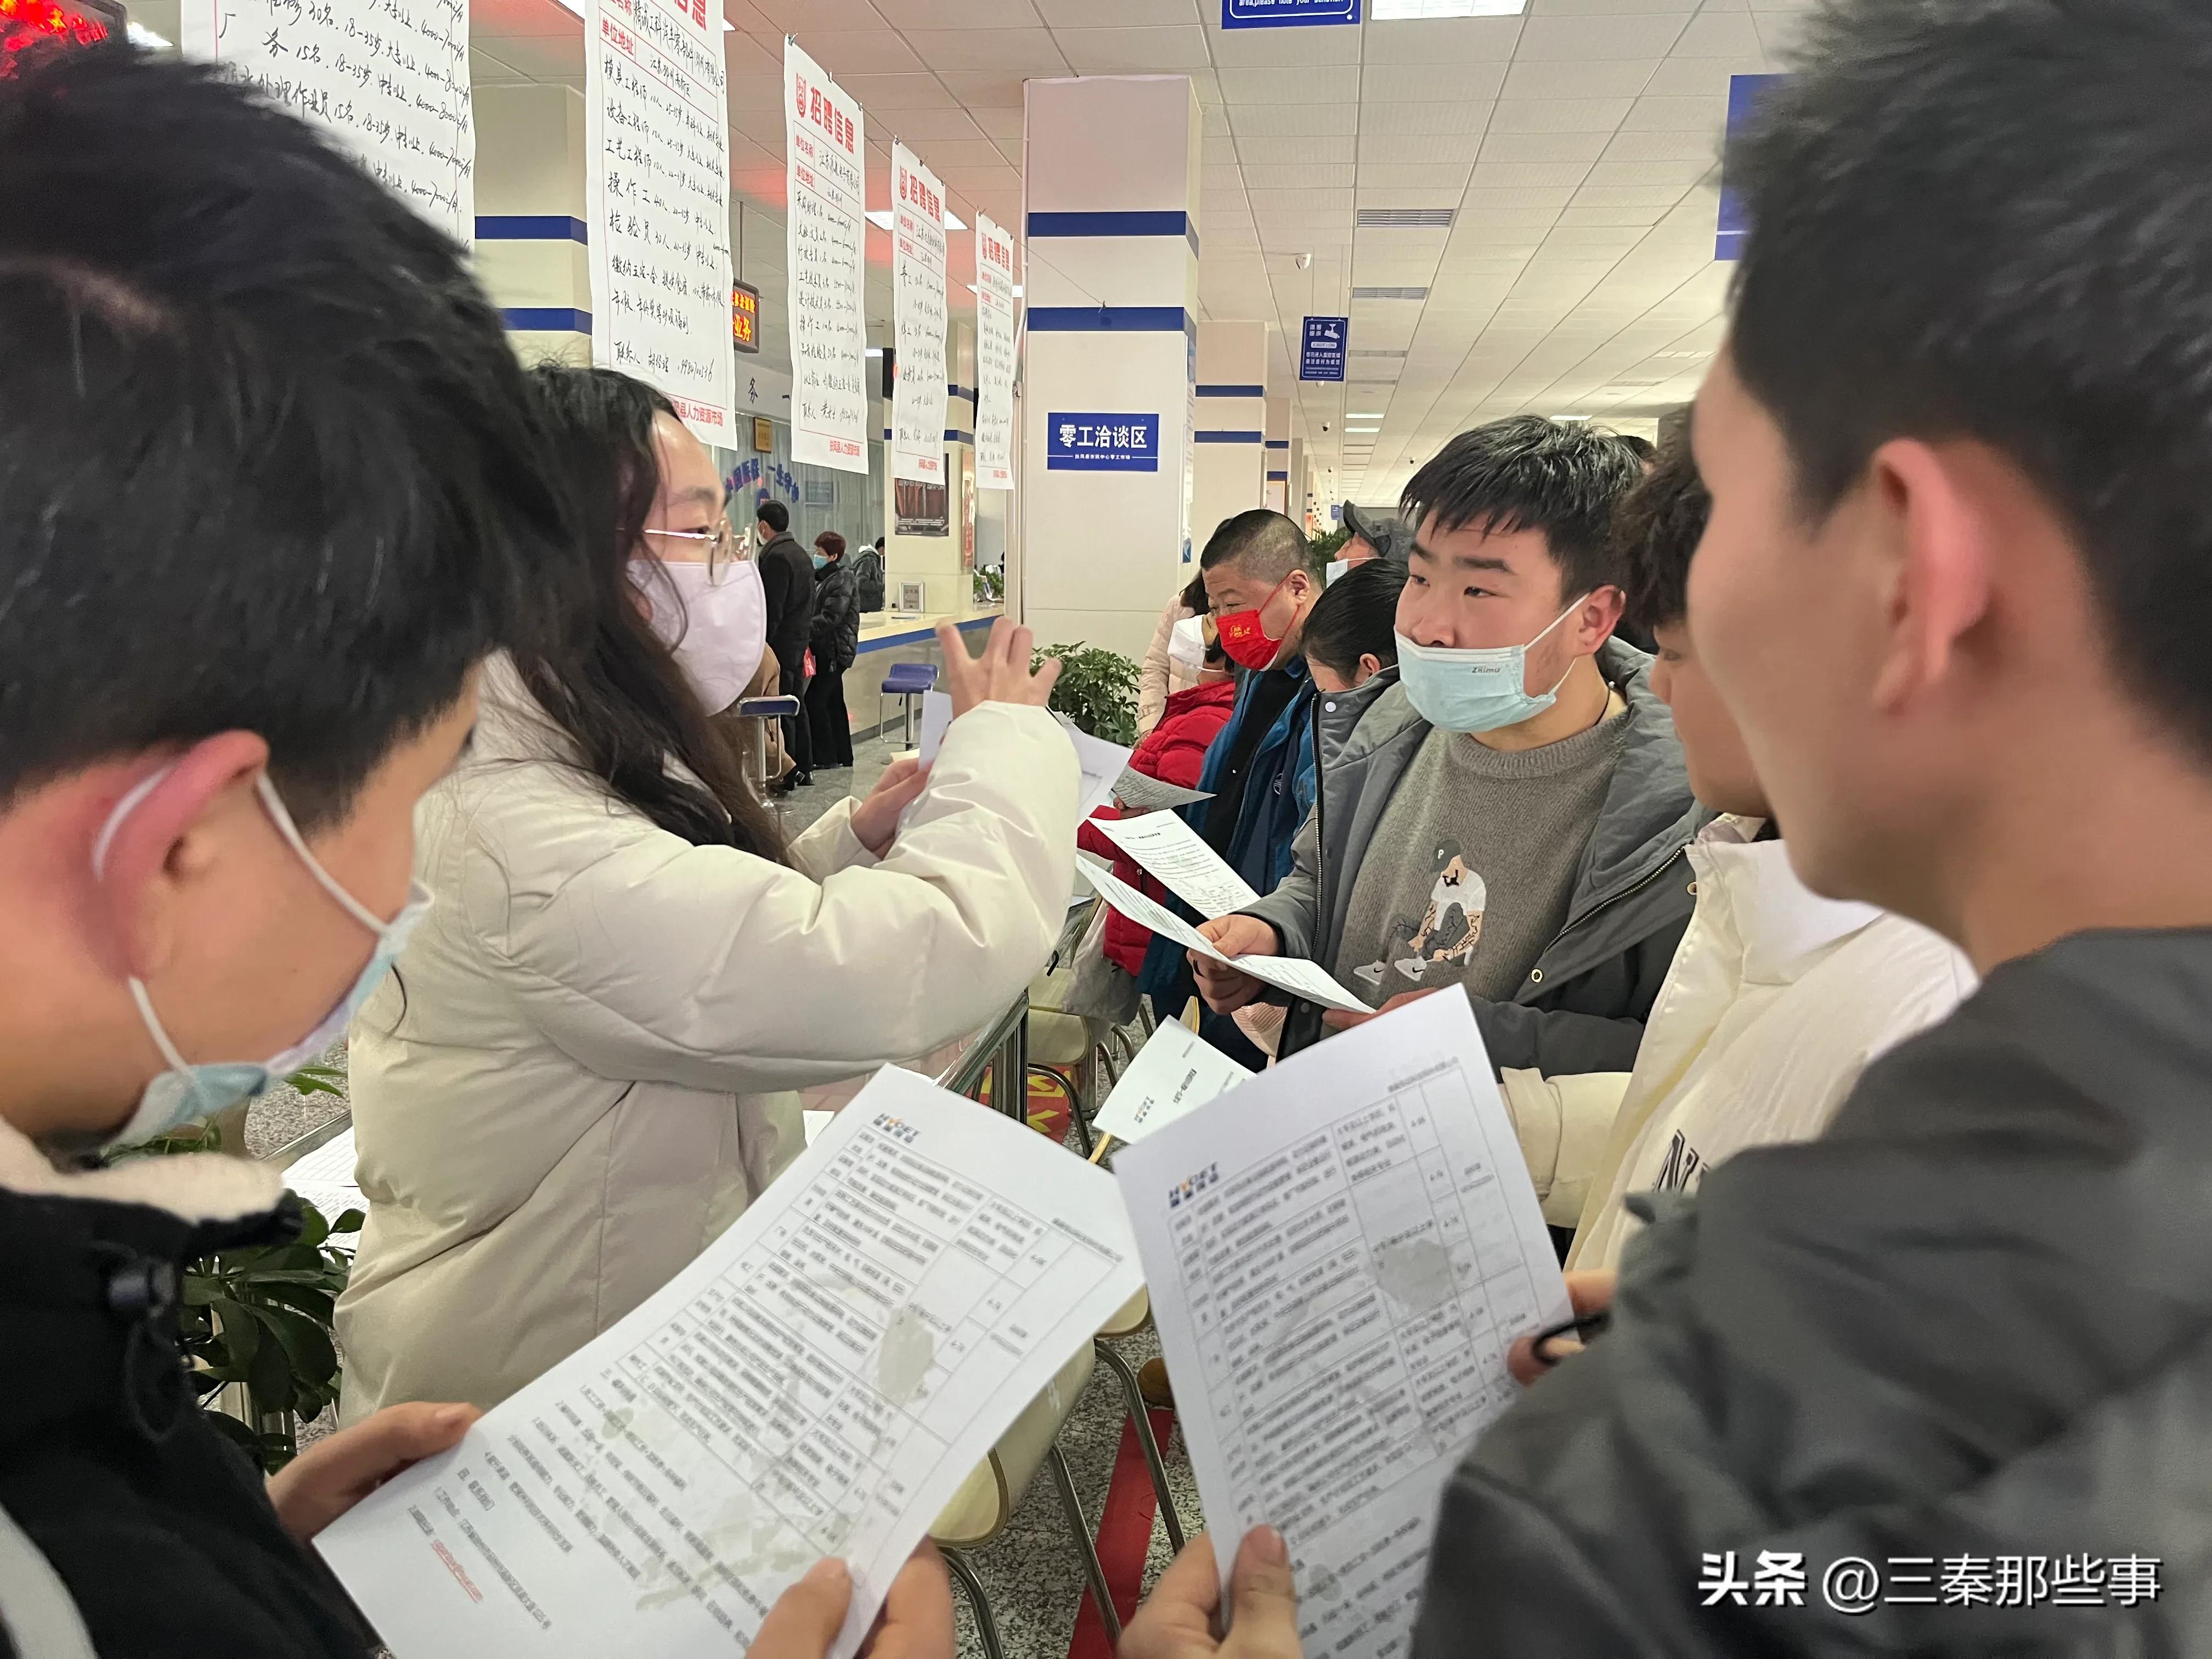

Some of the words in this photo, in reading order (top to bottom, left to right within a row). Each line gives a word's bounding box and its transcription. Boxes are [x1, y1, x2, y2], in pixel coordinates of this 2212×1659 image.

[602, 18, 634, 56] 单位地址
[810, 86, 854, 155] 招聘信息
[910, 174, 941, 223] 招聘信息
[1059, 425, 1147, 448] 零工洽谈区
